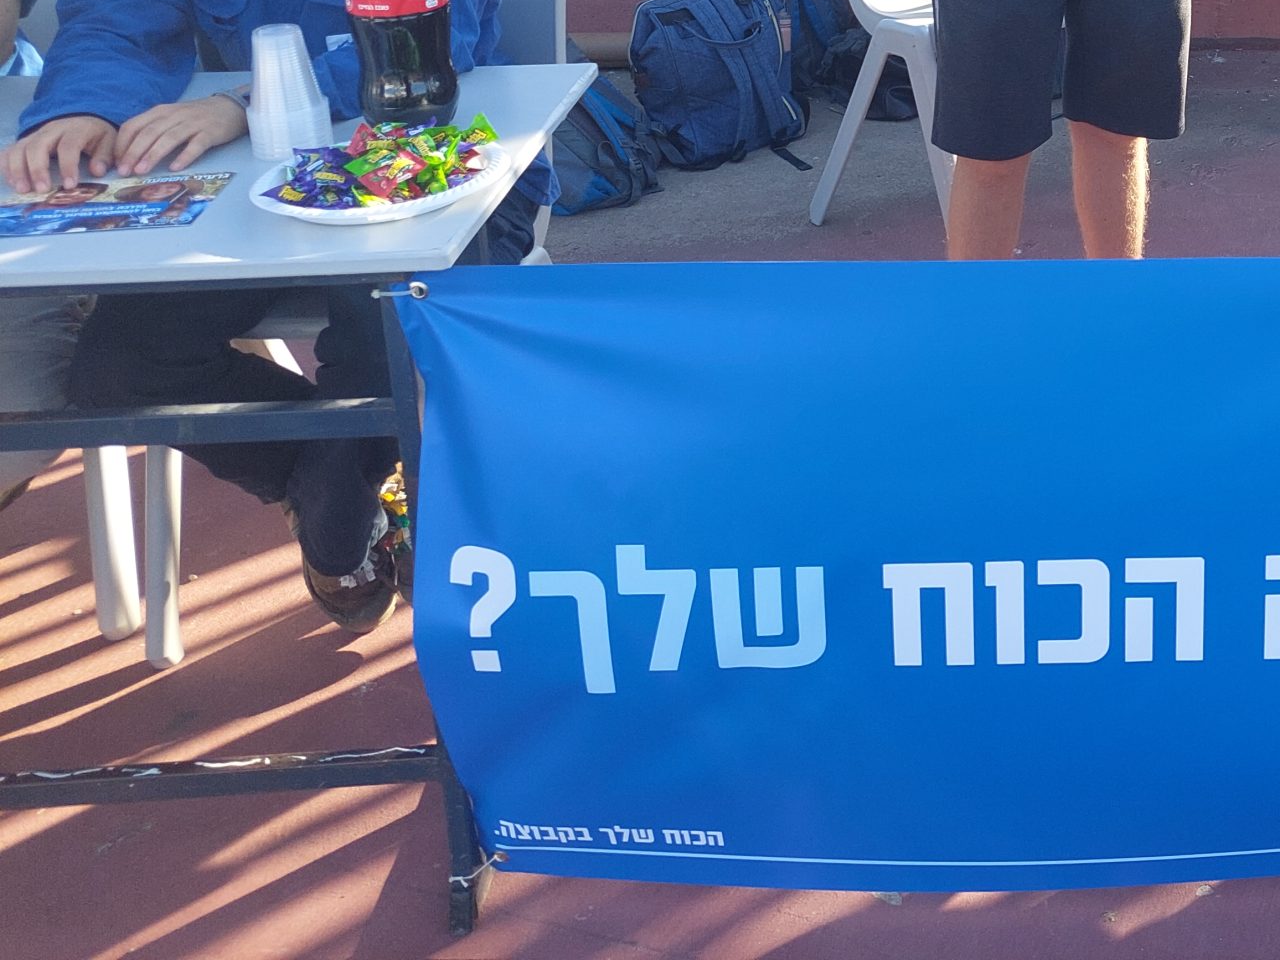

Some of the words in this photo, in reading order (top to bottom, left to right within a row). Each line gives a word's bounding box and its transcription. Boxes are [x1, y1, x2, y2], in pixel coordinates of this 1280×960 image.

[448, 542, 828, 695] שלך?
[881, 555, 1206, 668] הכוח
[493, 819, 594, 844] בקבוצה.
[598, 825, 655, 845] שלך
[662, 829, 725, 847] הכוח
